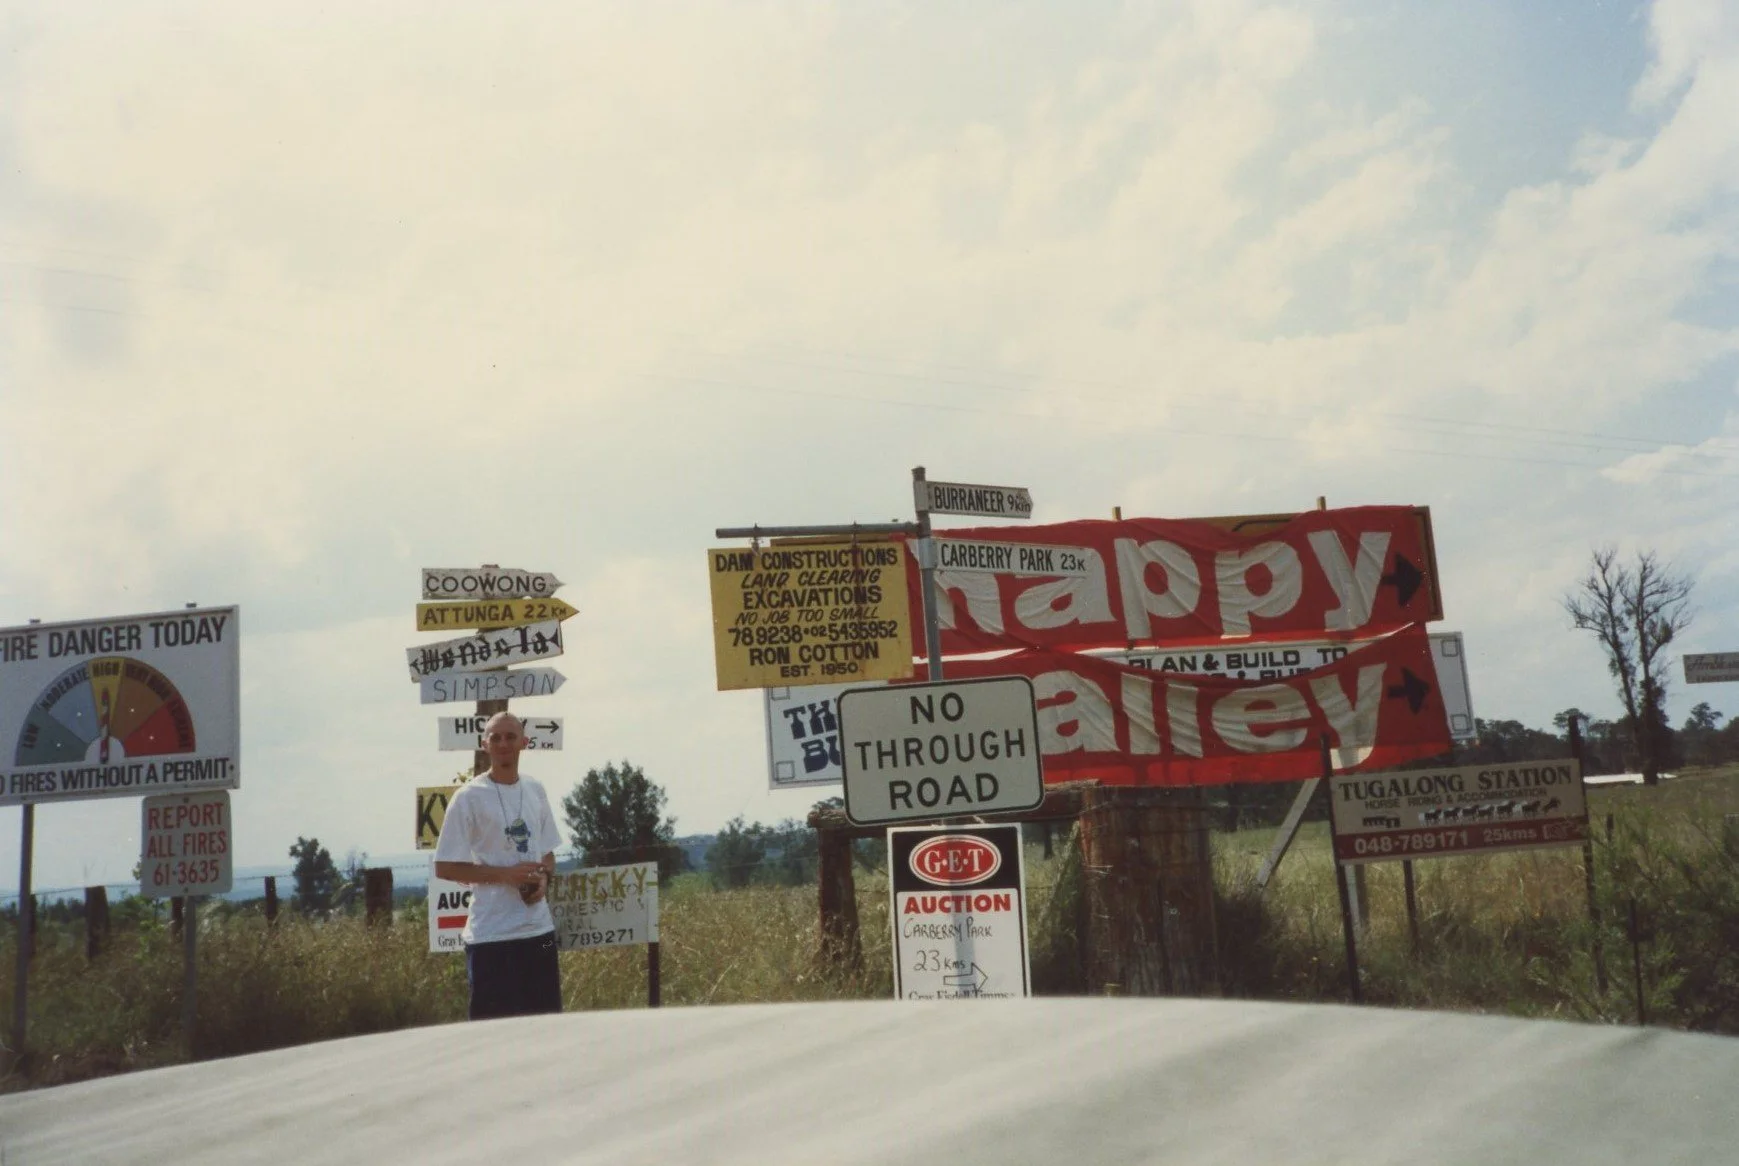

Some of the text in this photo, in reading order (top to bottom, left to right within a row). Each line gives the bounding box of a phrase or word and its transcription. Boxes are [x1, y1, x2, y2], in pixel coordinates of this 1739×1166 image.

[934, 486, 1005, 513] BURRANEER
[715, 547, 898, 573] DAM CONSTRUCTIONS
[941, 543, 1013, 570] CARBERRY
[1020, 548, 1054, 572] PARK
[426, 575, 546, 593] COOWONG
[741, 568, 882, 589] LAND CLEARING
[743, 585, 882, 611] EXCAVATIONS
[423, 604, 514, 626] ATTUNGA
[523, 604, 547, 620] 22
[735, 606, 879, 626] NO JOB TOO SMALL
[0, 616, 227, 662] IRE DANGER TODAY
[750, 641, 879, 666] RON COTTON
[1226, 649, 1299, 668] BUILD
[92, 661, 119, 676] HIGH
[821, 662, 858, 675] 1950
[433, 673, 556, 703] SIMPSON
[910, 691, 965, 725] NO
[1031, 662, 1387, 770] alley
[853, 727, 1026, 771] THROUGH
[10, 771, 57, 795] FIRES
[61, 764, 143, 790] WITHOUT
[145, 763, 160, 784] A
[162, 758, 230, 782] PERMIT
[1338, 765, 1572, 801] TUGALONG STATION
[888, 772, 1000, 811] ROAD
[148, 802, 224, 830] REPORT
[147, 830, 227, 859] ALL FIRES
[903, 893, 1012, 914] AUCTION
[569, 928, 634, 947] 789271
[913, 950, 940, 972] 23
